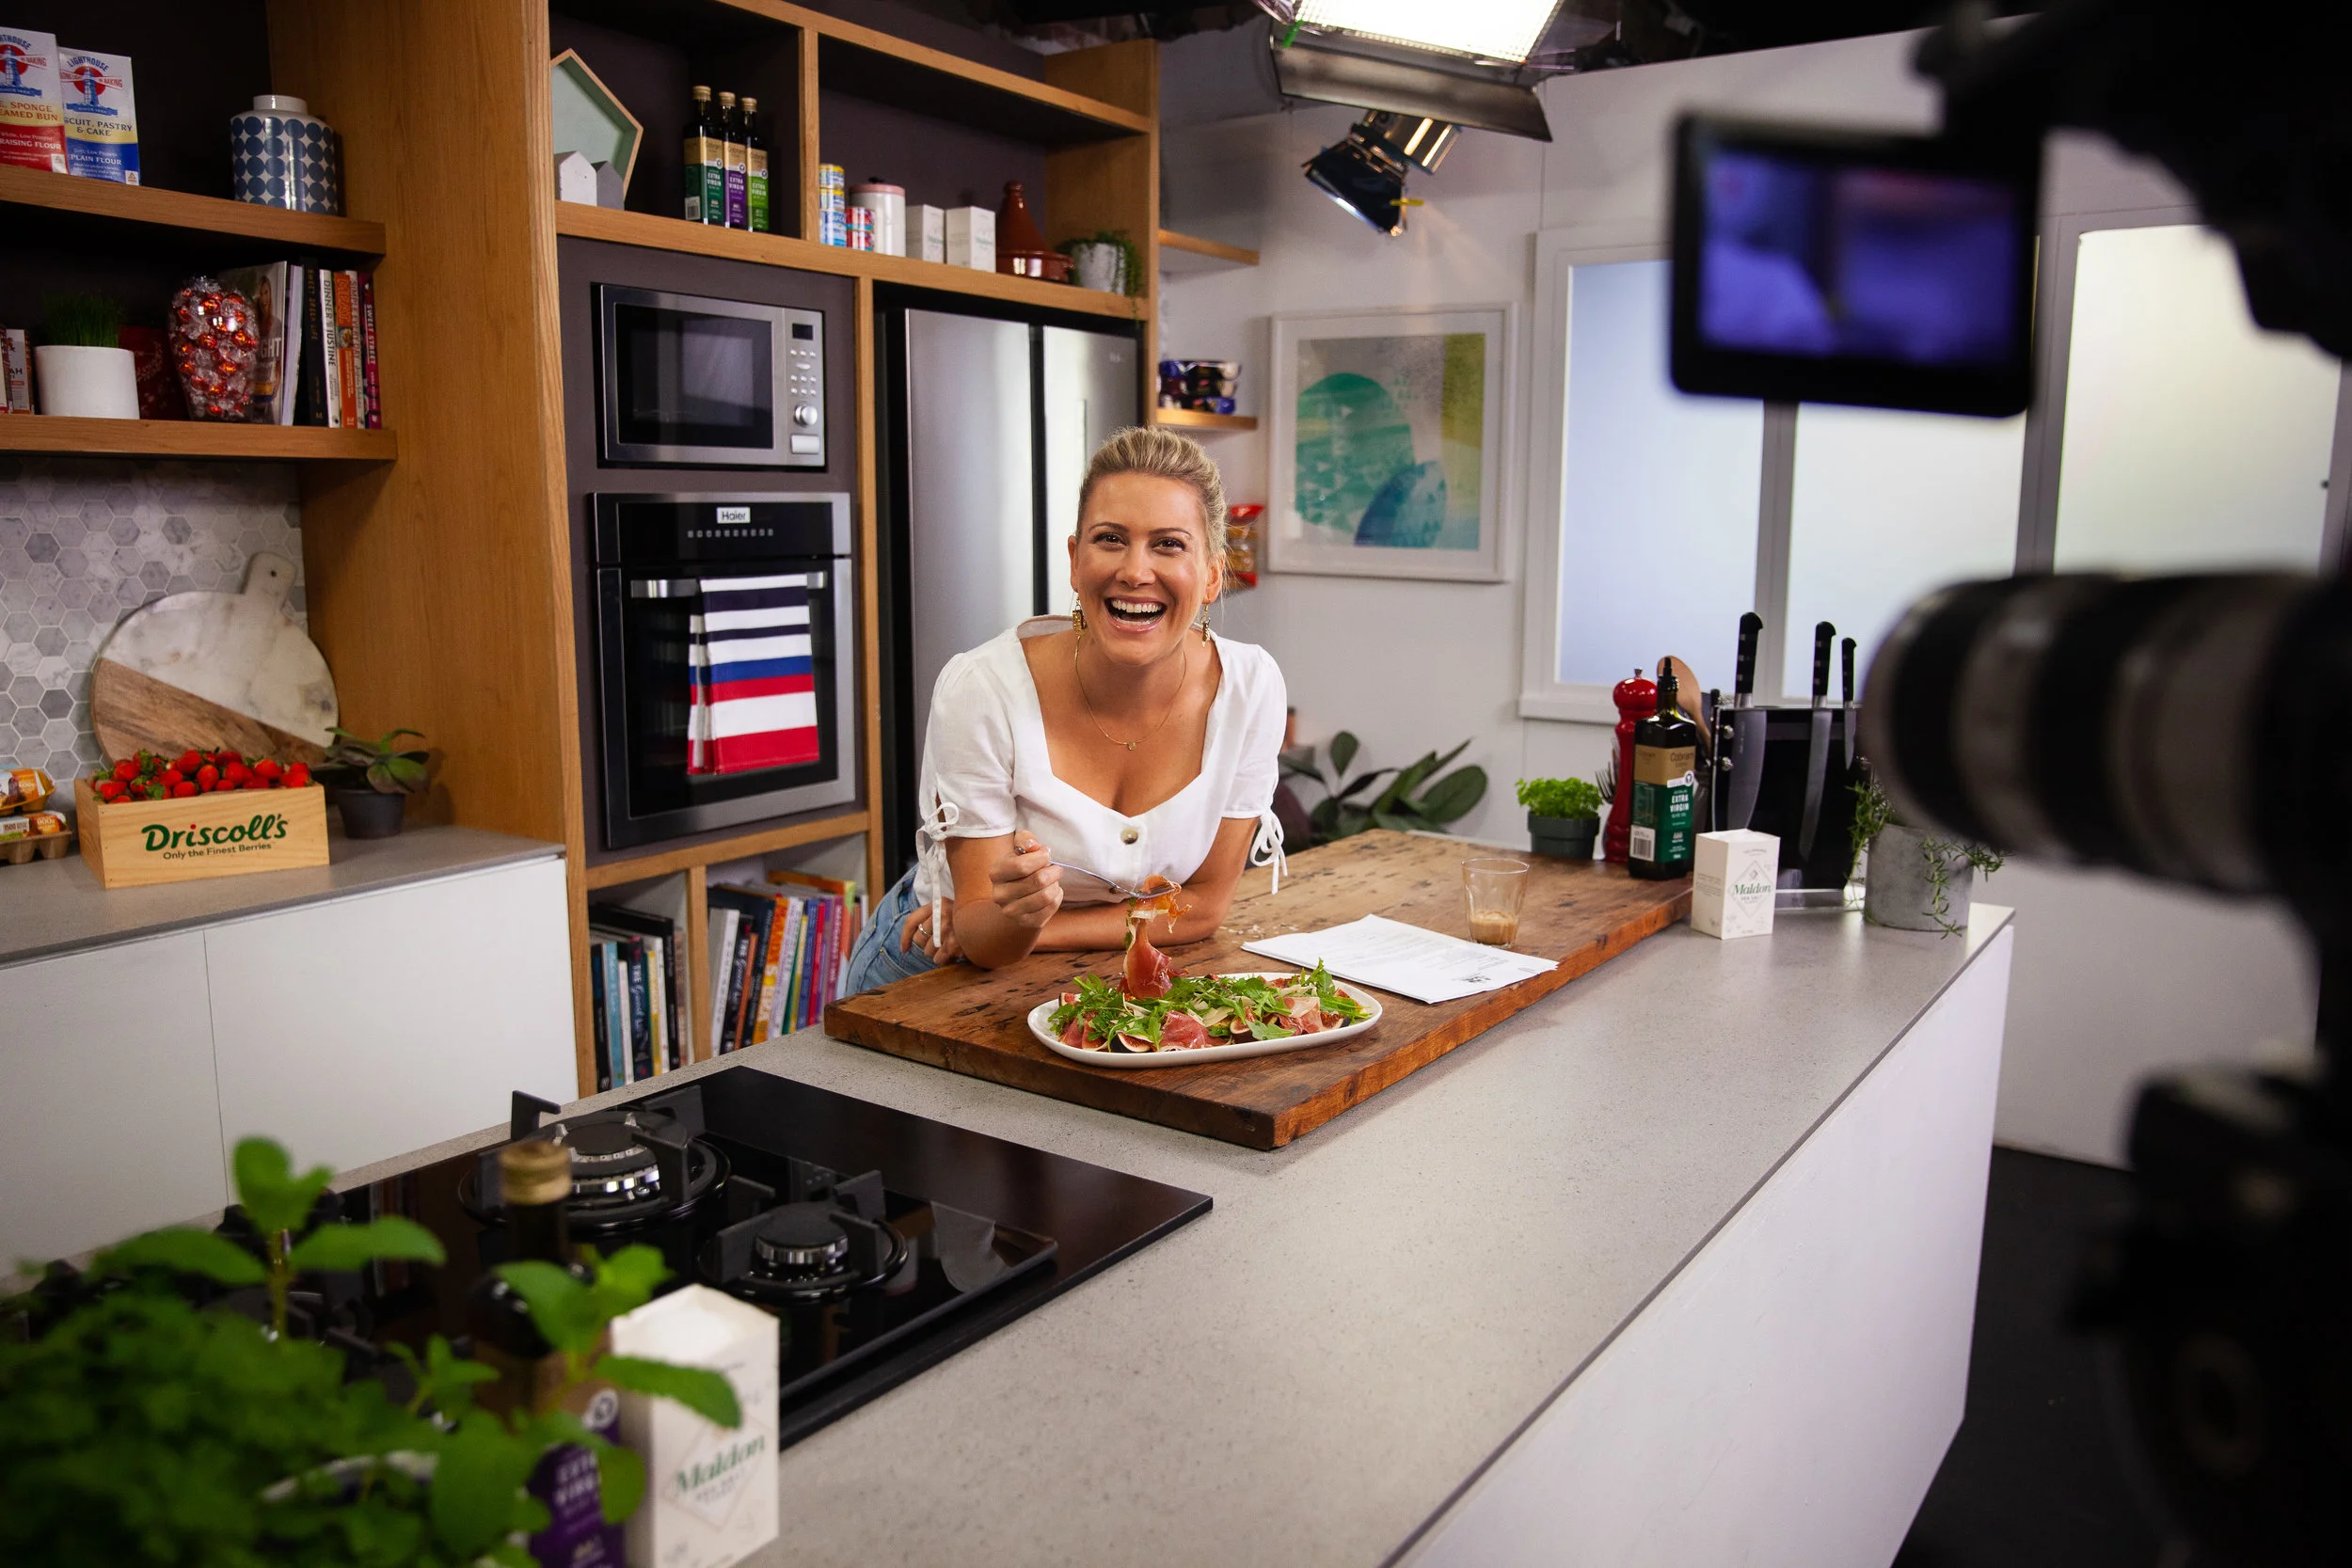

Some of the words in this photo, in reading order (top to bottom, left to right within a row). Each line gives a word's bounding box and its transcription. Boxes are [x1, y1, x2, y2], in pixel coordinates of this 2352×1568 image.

[67, 55, 109, 72] LIGHTHOUSE
[103, 77, 123, 87] BAKING
[10, 102, 53, 112] SPONGE
[37, 113, 58, 121] BUN
[87, 127, 111, 136] CAKE
[97, 121, 133, 132] PASTRY
[35, 141, 62, 150] FLOUR
[71, 153, 94, 162] PLAIN
[96, 156, 122, 165] FLOUR
[324, 279, 332, 319] DINNER
[366, 304, 374, 332] SWEET
[326, 329, 336, 367] JUSTINE
[368, 334, 376, 364] STREET
[722, 510, 746, 521] Haier
[1672, 794, 1689, 803] EXTRA
[1670, 802, 1691, 813] VIRGIN
[141, 813, 289, 851] Driscoll's
[163, 850, 186, 860] Only
[188, 849, 204, 858] the
[206, 847, 236, 856] Finest
[238, 843, 272, 852] Berries
[1734, 882, 1771, 895] Maldon
[675, 1434, 766, 1494] Maldon
